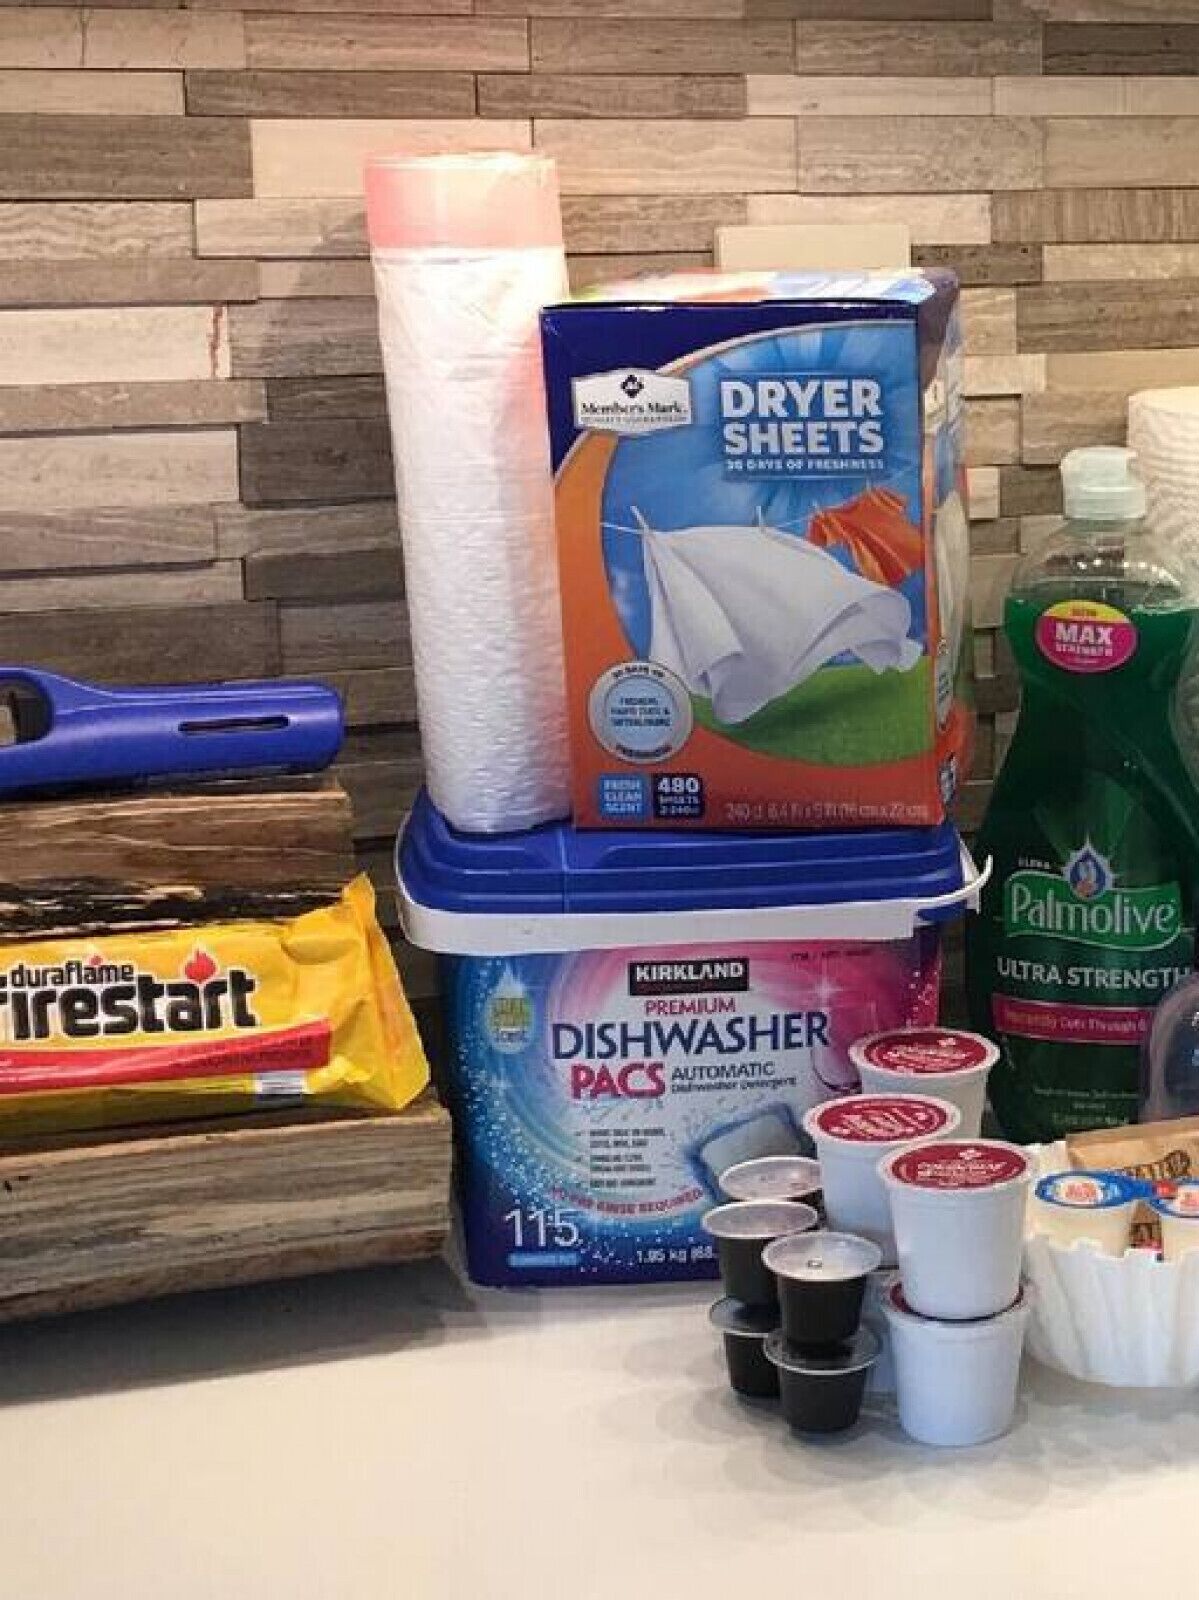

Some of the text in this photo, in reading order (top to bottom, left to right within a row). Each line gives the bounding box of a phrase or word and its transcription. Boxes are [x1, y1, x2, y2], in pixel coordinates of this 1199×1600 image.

[721, 378, 884, 418] DRYER
[723, 421, 885, 454] SHEETS
[1055, 622, 1114, 645] MAX
[657, 777, 700, 794] 480
[1010, 882, 1177, 935] Palmolive
[11, 960, 134, 988] duraflame
[635, 962, 744, 982] KIRKLAND
[997, 957, 1190, 989] ULTRA STRENGTH
[0, 969, 257, 1040] irestart
[645, 997, 737, 1017] PREMIUM
[552, 1011, 831, 1061] DISHWASHER
[570, 1061, 667, 1100] PACS
[671, 1061, 775, 1082] AUTOMATIC
[504, 1208, 581, 1247] 115
